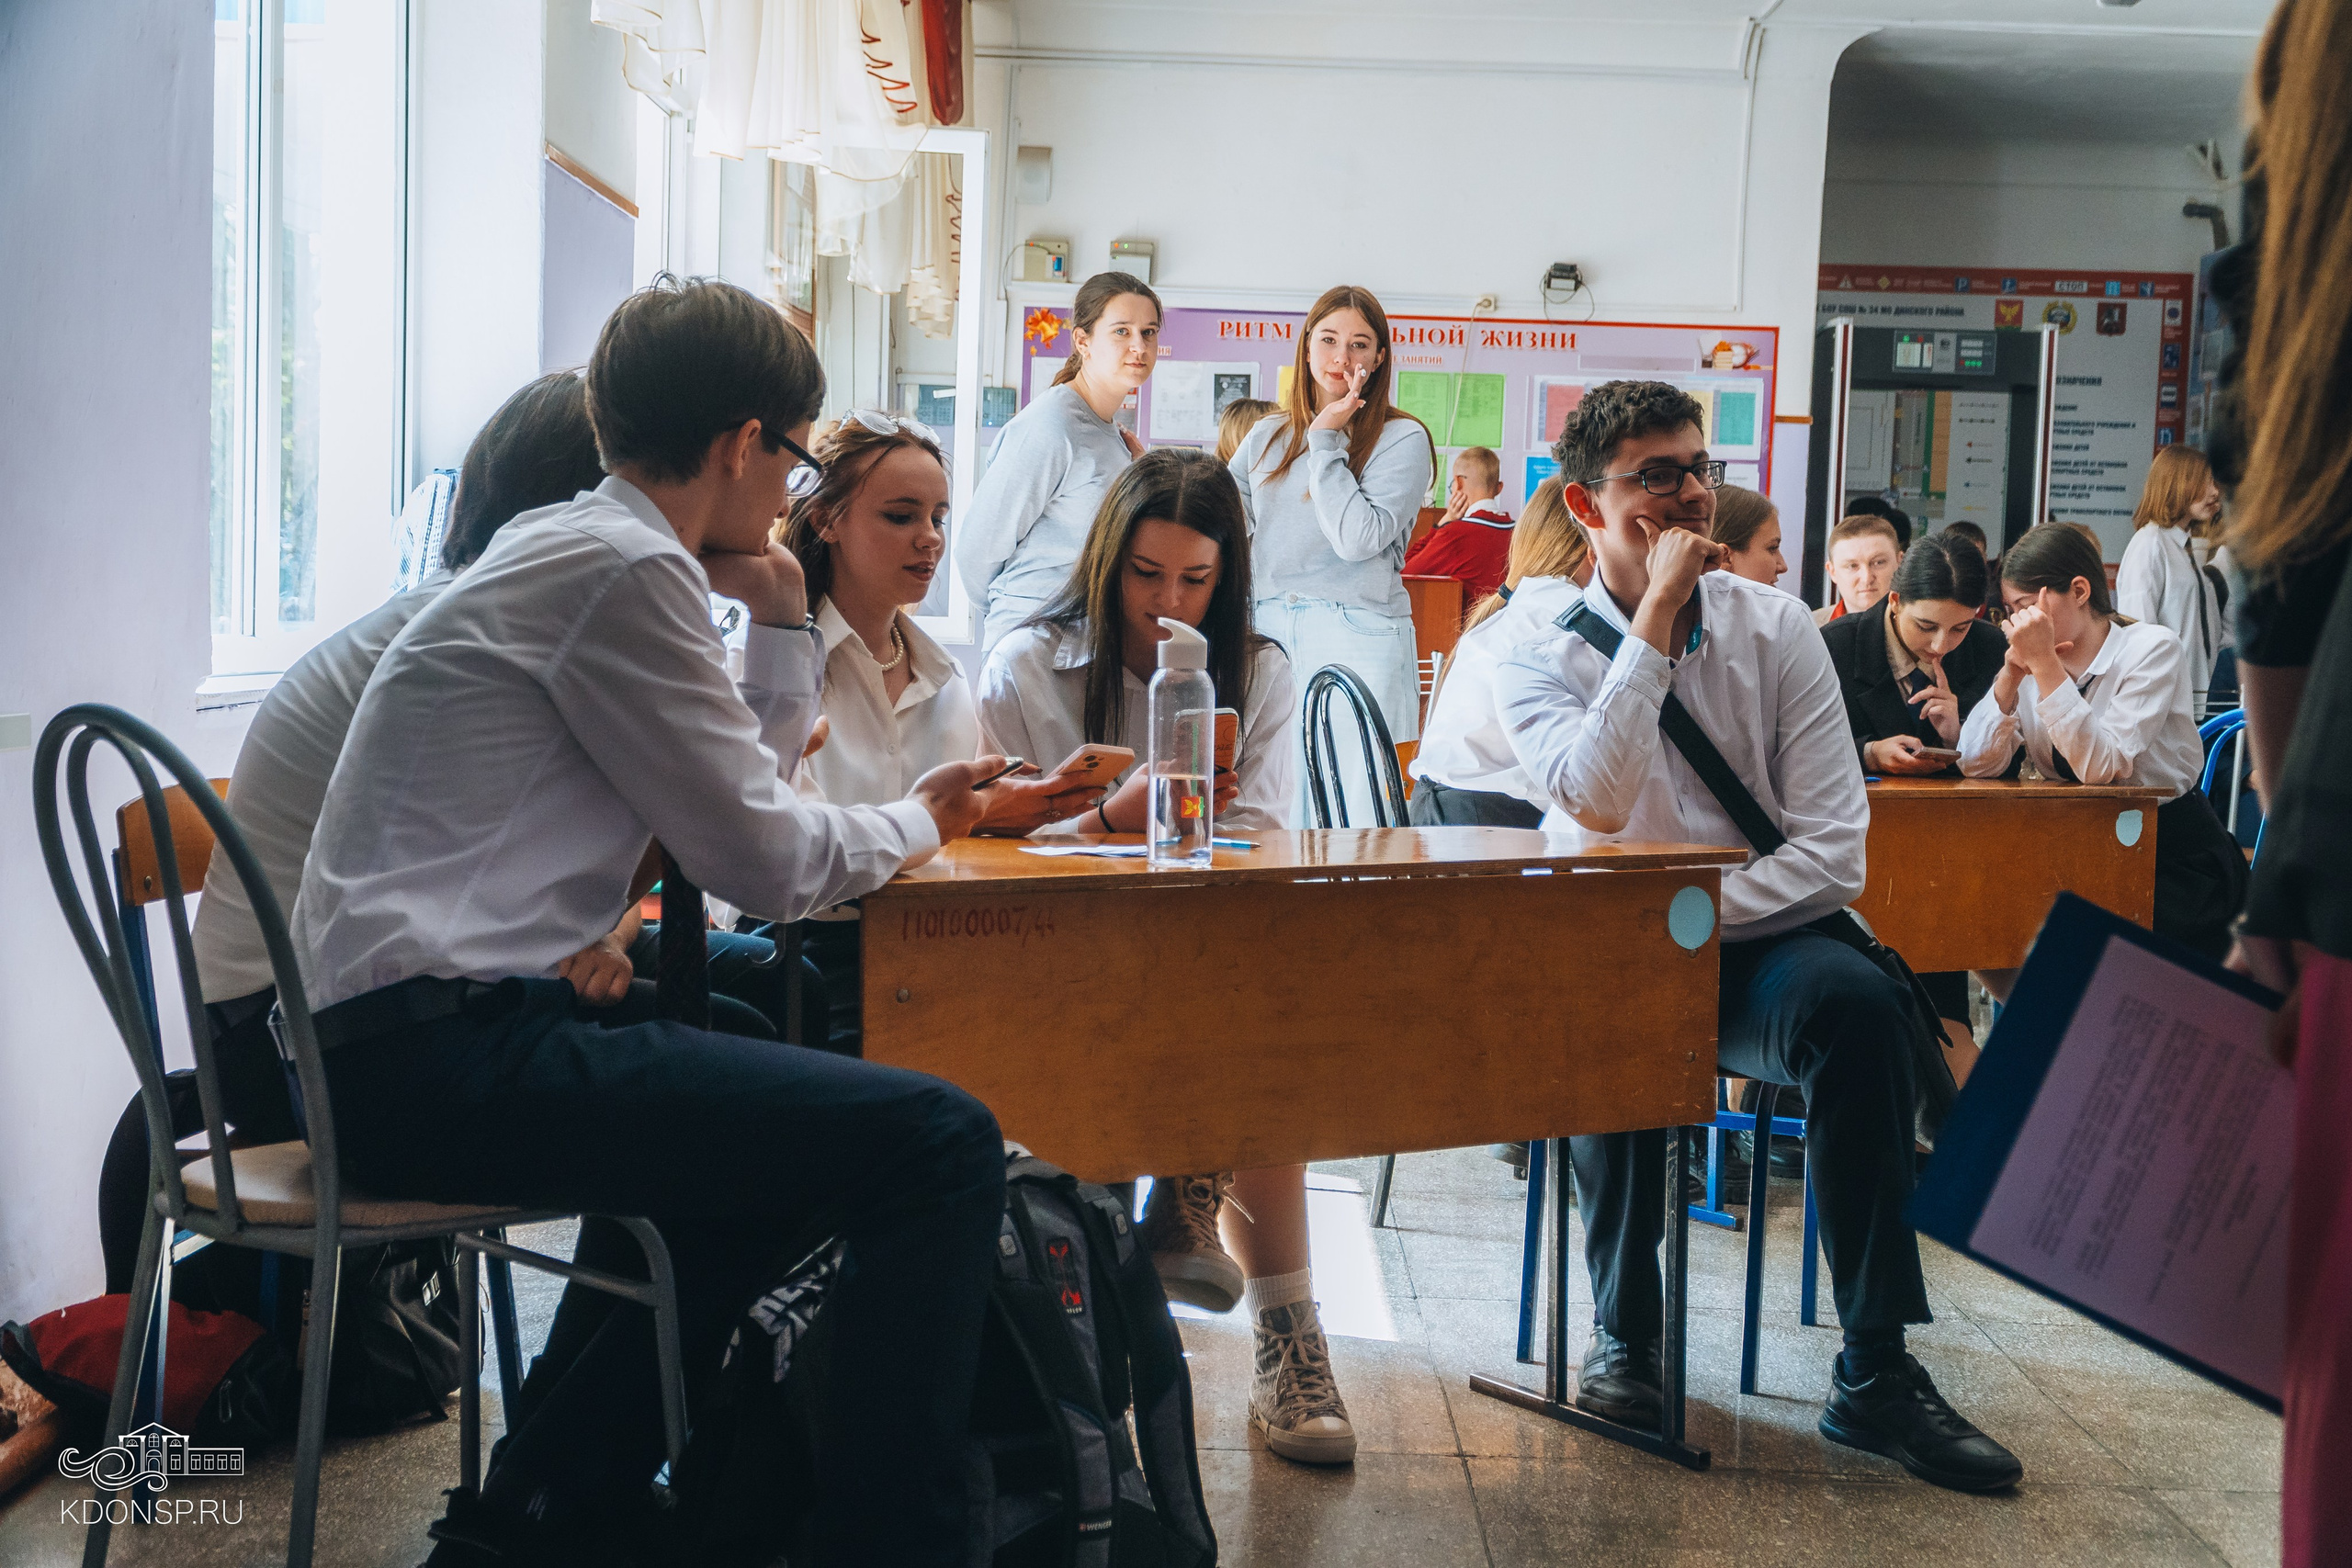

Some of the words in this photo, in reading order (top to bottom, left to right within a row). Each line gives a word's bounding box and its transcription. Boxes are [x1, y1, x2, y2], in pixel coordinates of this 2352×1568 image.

[1219, 321, 1292, 339] РИТМ
[1392, 324, 1464, 345] ЬНОЙ
[1481, 330, 1577, 349] ЖИЗНИ
